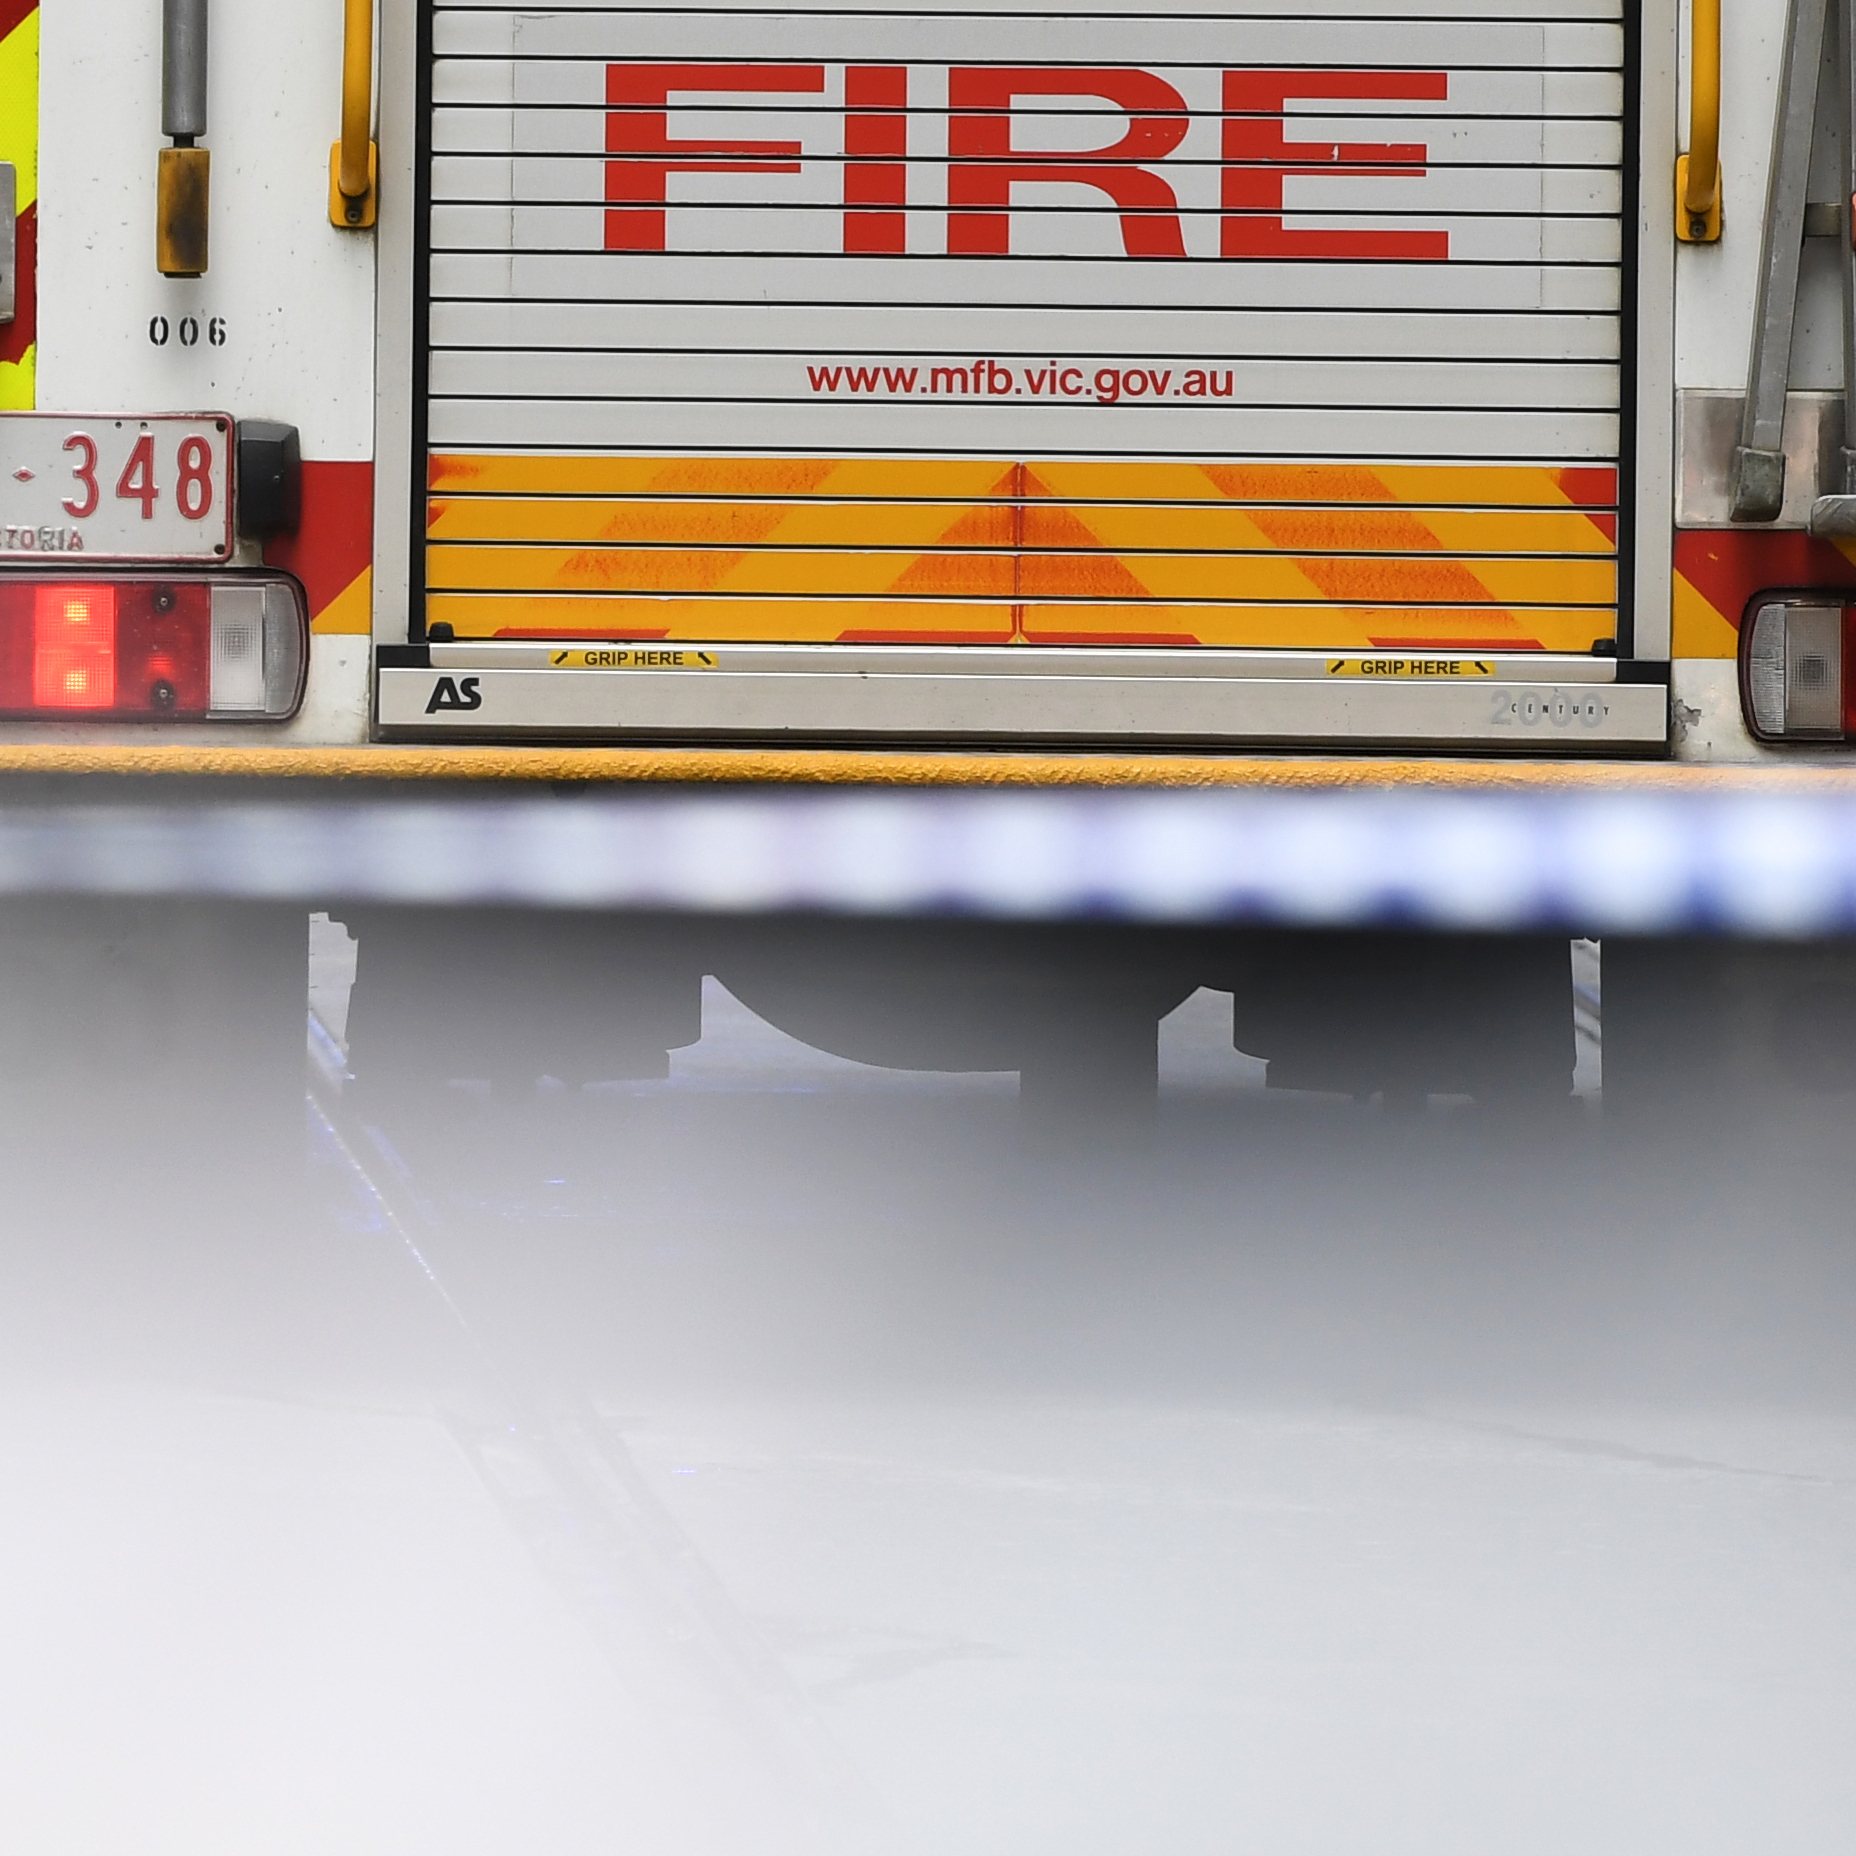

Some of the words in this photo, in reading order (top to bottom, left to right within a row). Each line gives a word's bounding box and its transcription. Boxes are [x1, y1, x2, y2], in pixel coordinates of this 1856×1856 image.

[604, 63, 1450, 261] FIRE
[148, 315, 228, 347] 006
[807, 359, 1235, 403] www.mfb.vic.gov.au
[61, 434, 214, 521] 348
[584, 651, 628, 666] GRIP
[634, 651, 684, 666] HERE
[1360, 660, 1405, 675] GRIP
[1410, 661, 1461, 675] HERE
[424, 676, 483, 715] AS
[1491, 689, 1604, 729] 2000
[1511, 703, 1610, 716] CENTURY
